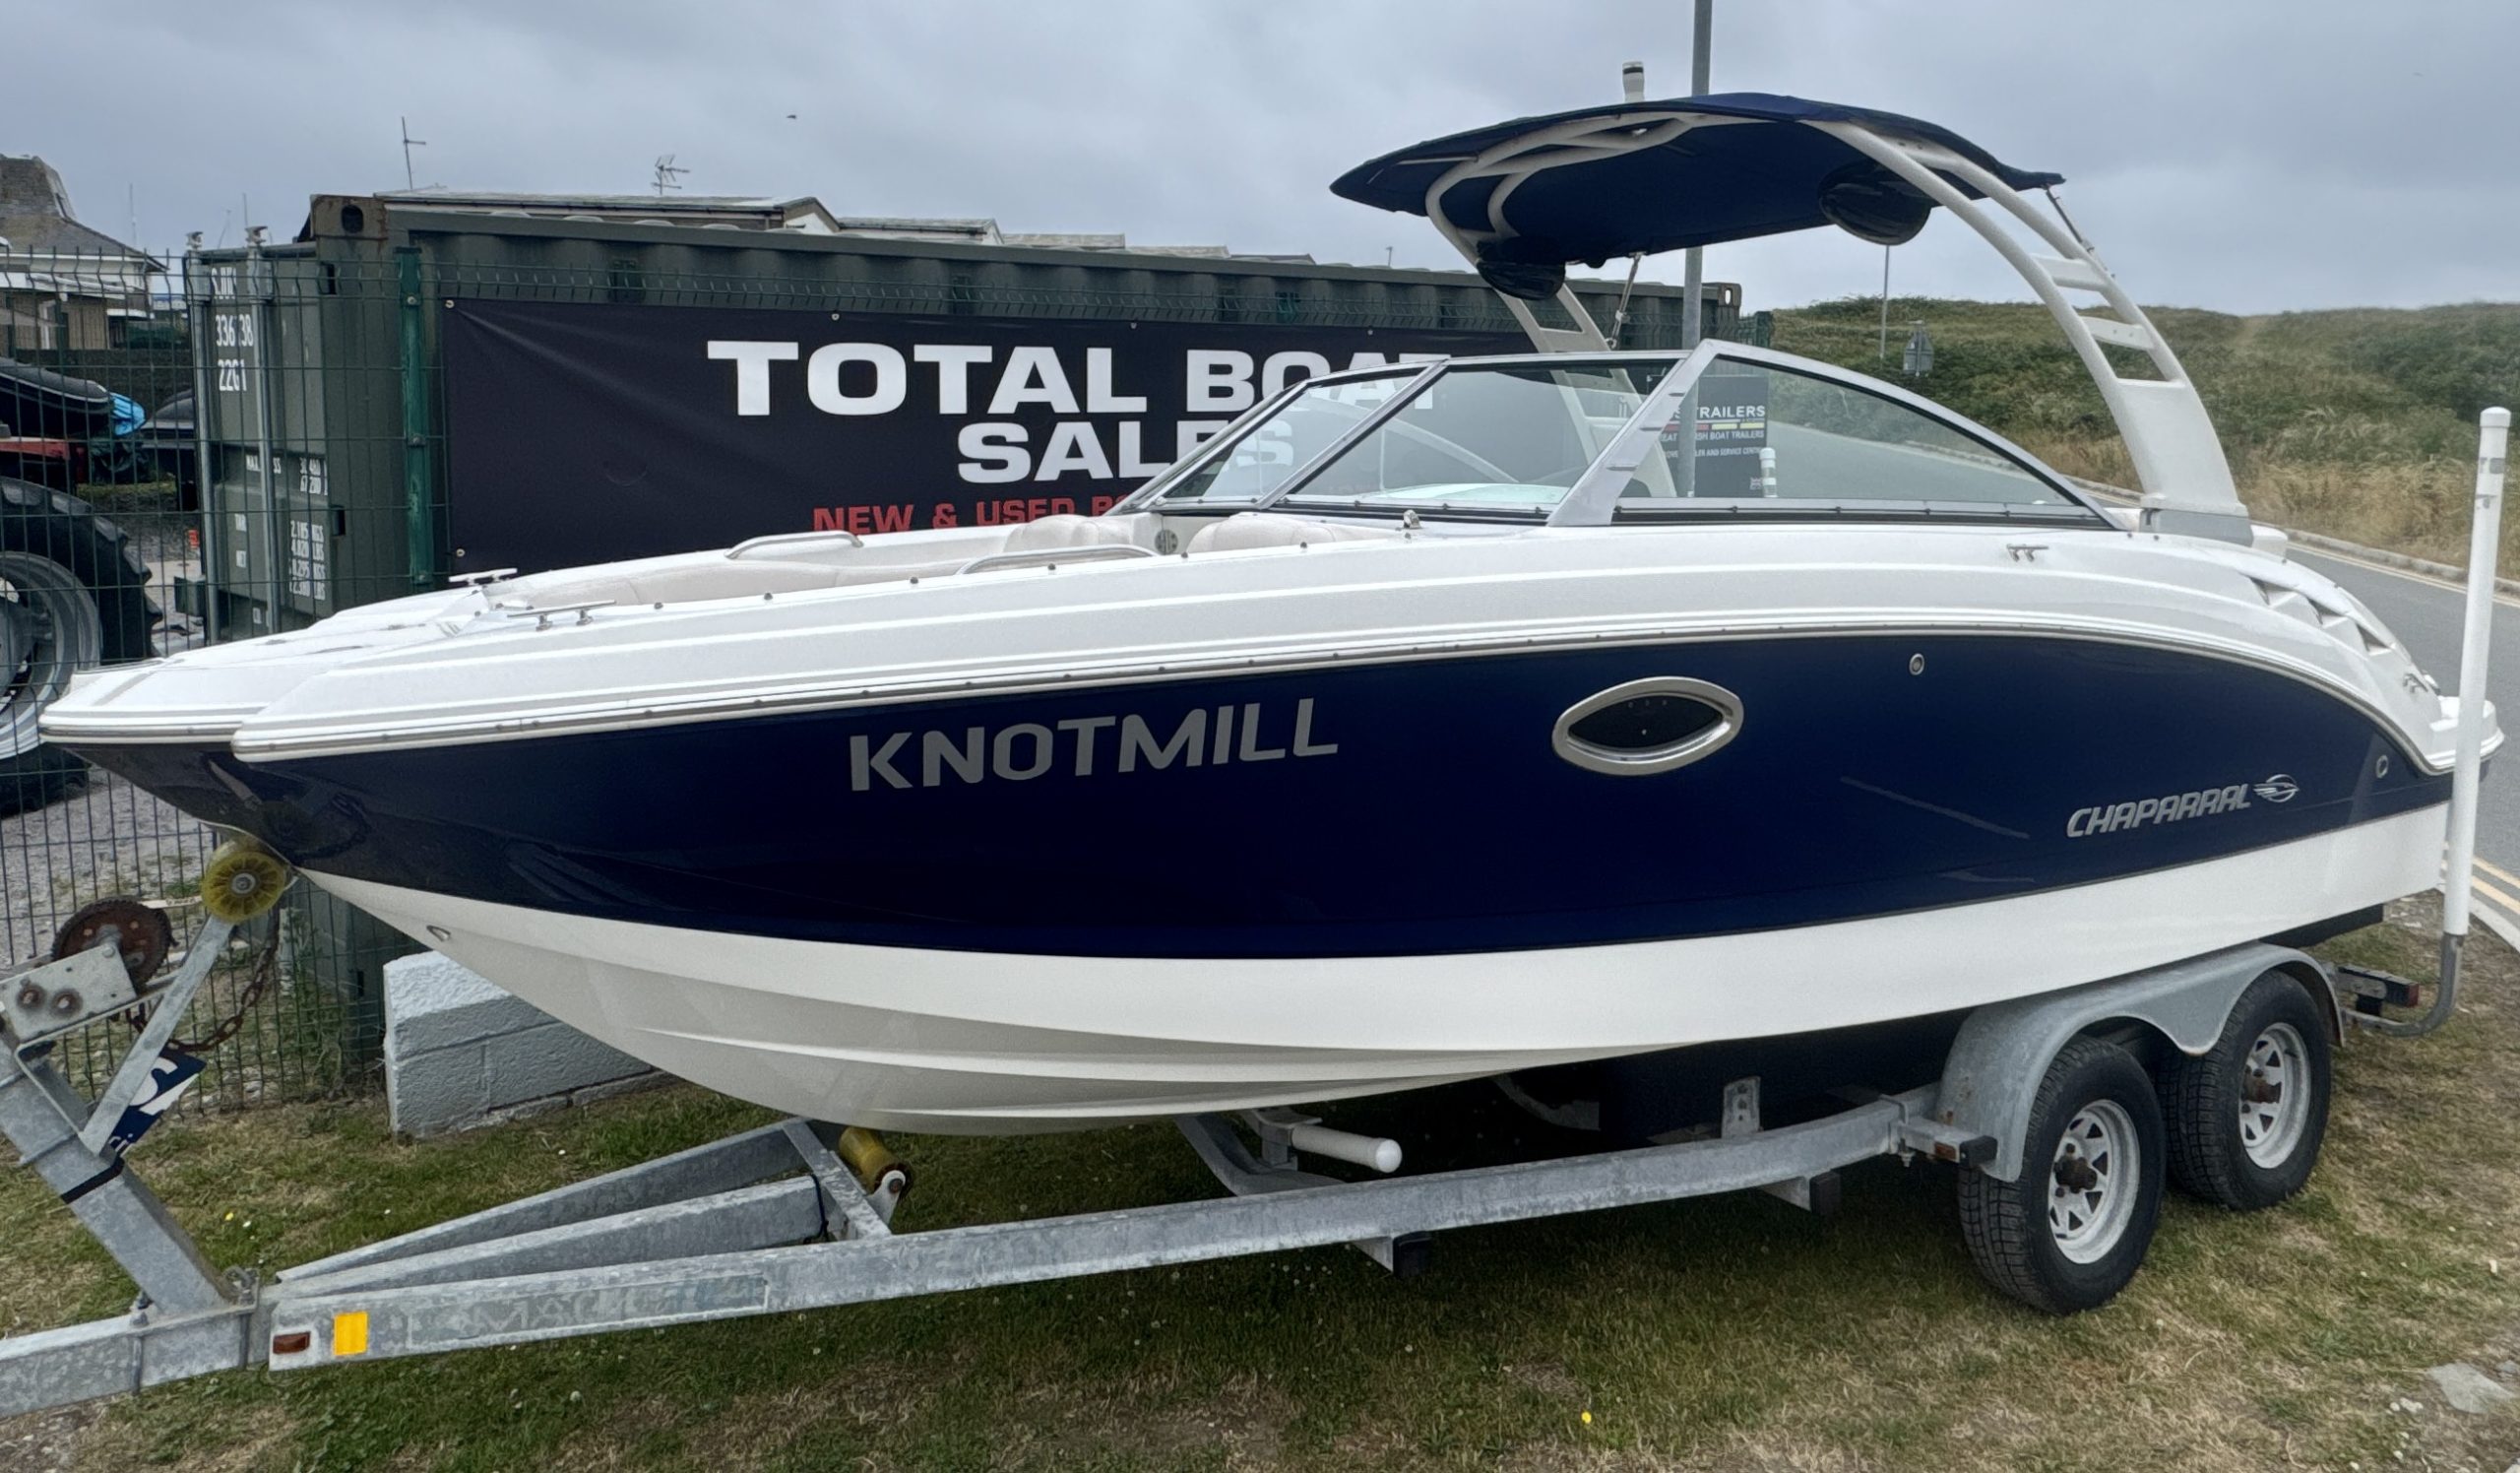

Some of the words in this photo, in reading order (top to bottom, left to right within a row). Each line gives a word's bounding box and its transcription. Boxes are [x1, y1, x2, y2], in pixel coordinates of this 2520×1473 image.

[707, 341, 1148, 416] TOTAL
[1186, 349, 1452, 411] BOAT
[1697, 405, 1766, 418] RAILERS
[812, 504, 914, 535] NEW
[932, 503, 958, 529] &
[850, 697, 1339, 791] KNOTMILL
[2067, 784, 2251, 837] CHAPARRAL
